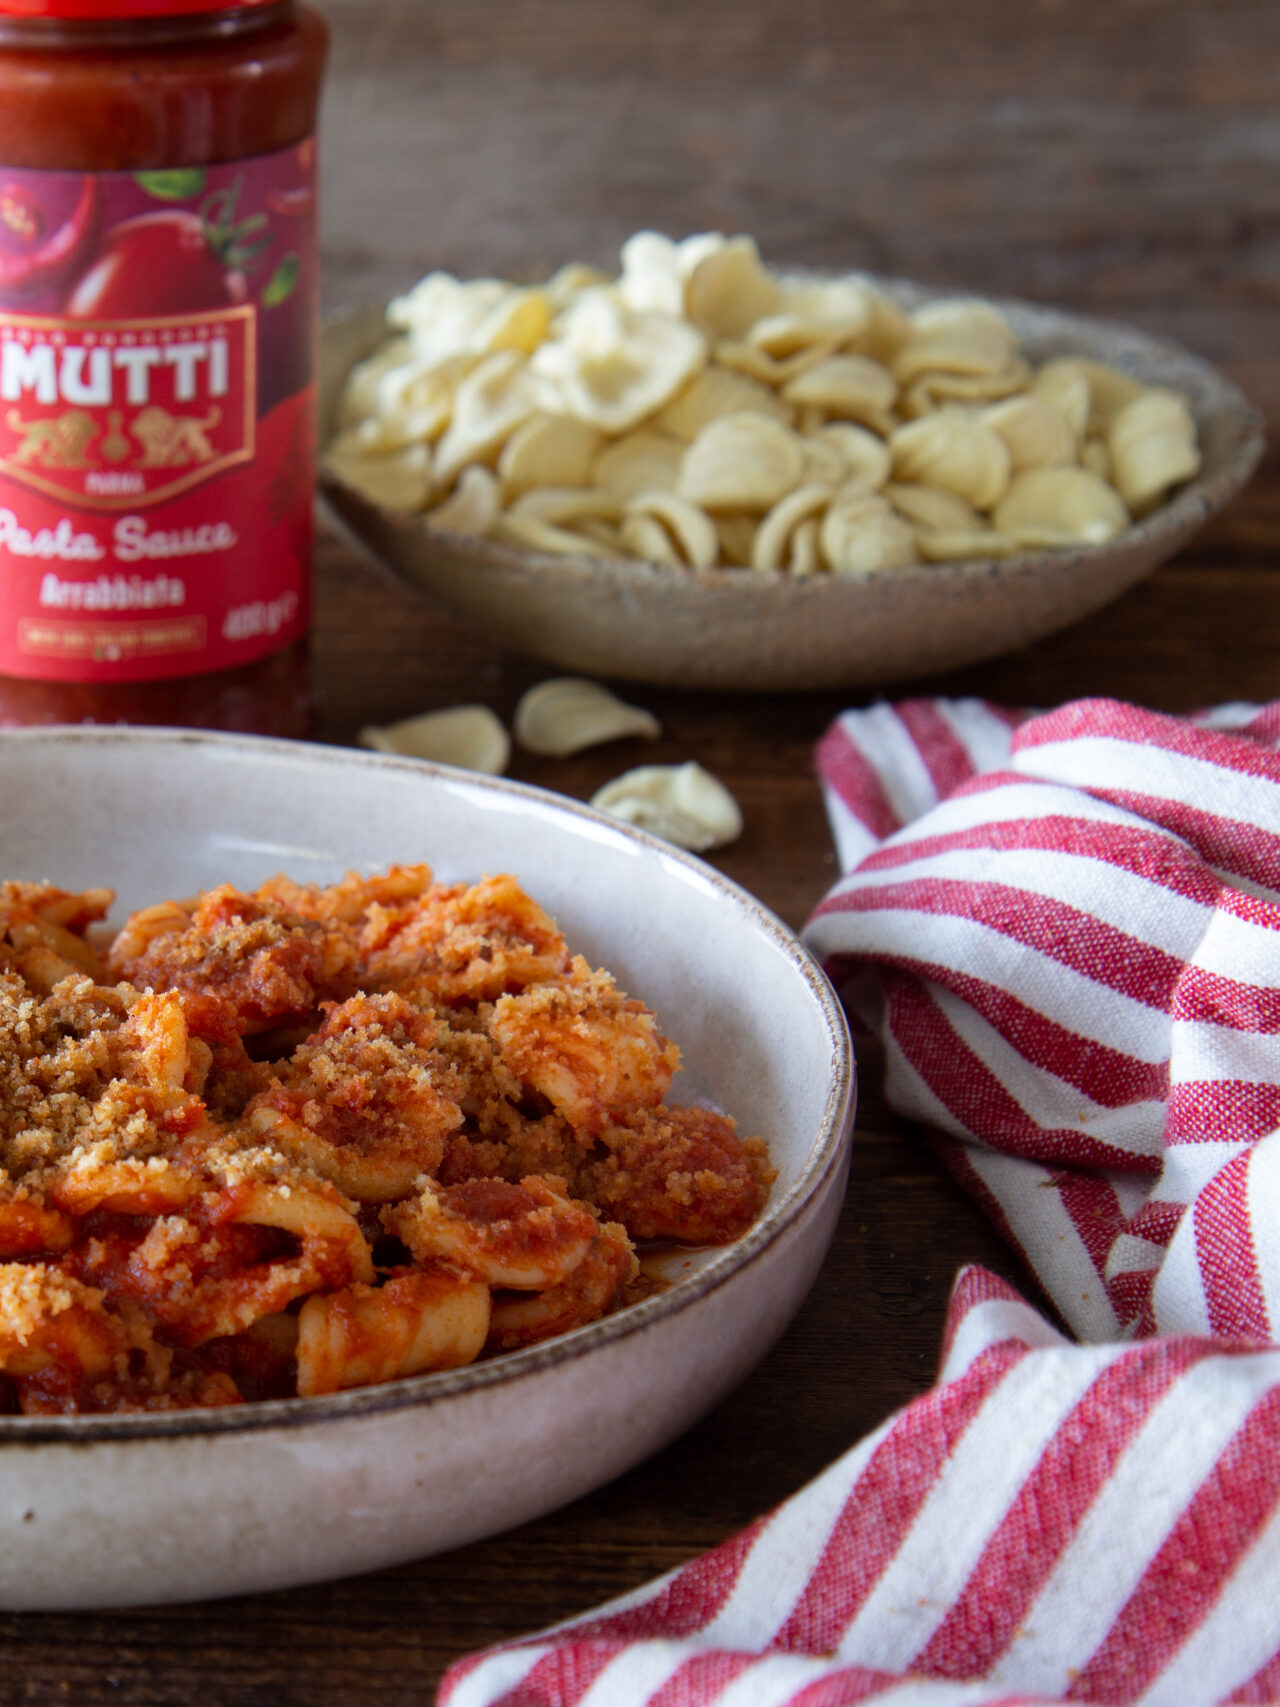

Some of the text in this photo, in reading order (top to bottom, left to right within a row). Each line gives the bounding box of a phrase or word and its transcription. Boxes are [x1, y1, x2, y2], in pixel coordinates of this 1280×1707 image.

[0, 338, 229, 405] MUTTI
[113, 516, 238, 561] Sauce
[40, 573, 185, 610] Arrabbiata
